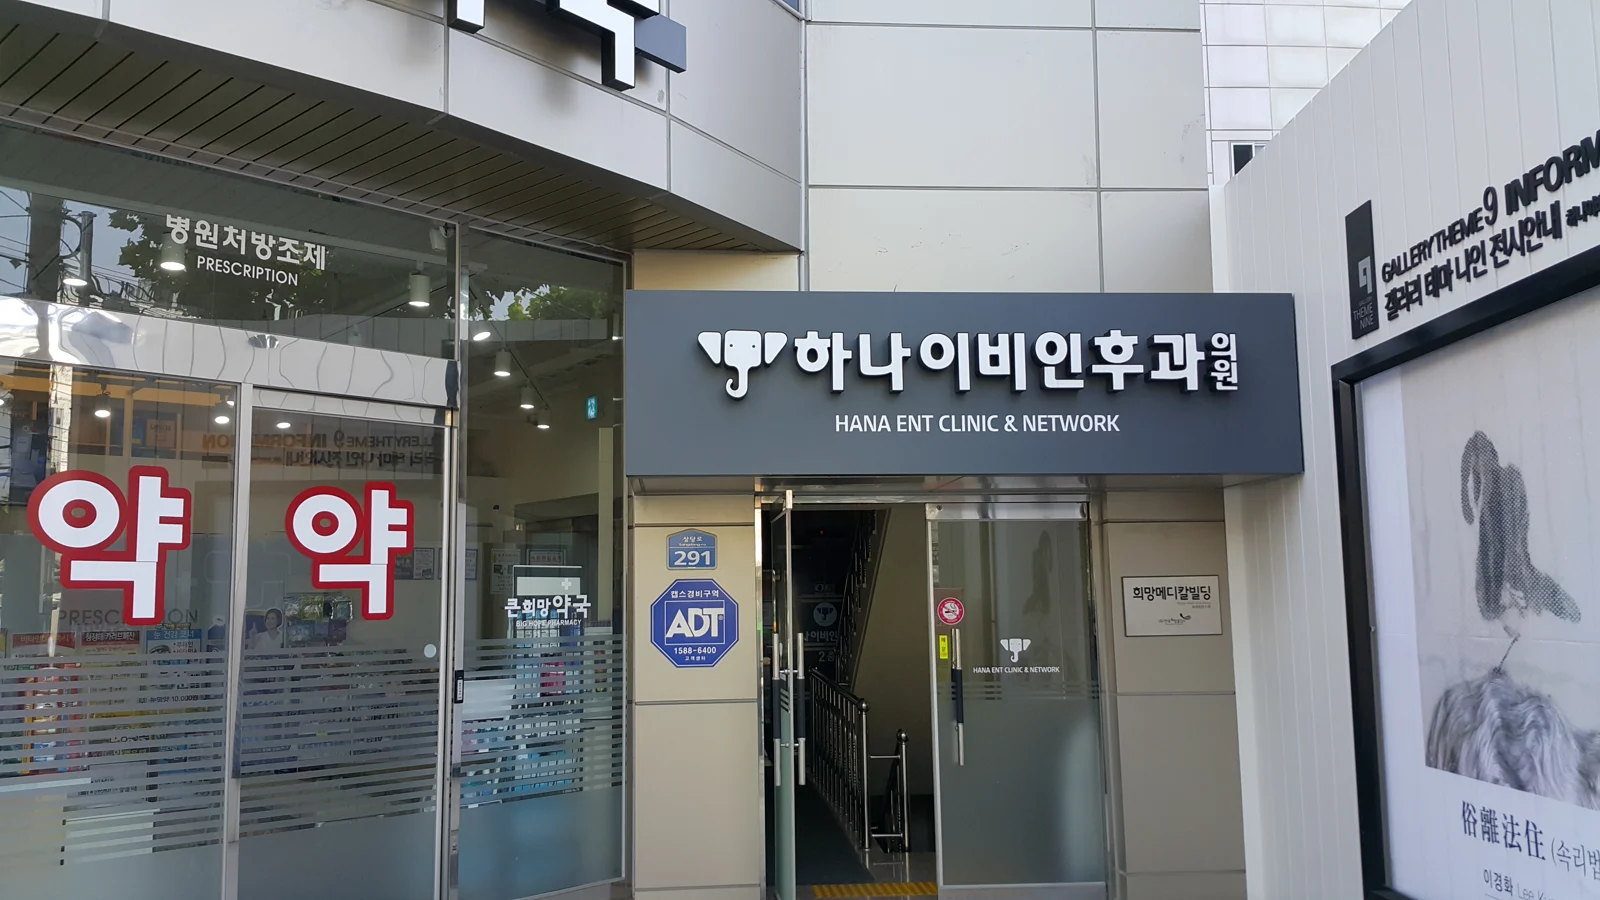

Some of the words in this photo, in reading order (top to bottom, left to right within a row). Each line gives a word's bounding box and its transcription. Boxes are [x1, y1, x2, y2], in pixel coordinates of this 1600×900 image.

[166, 214, 326, 270] 병원처방조제
[197, 255, 299, 287] PRESCRIPTION
[1384, 274, 1423, 321] 갤러리
[1424, 259, 1454, 298] 테마
[1455, 240, 1488, 282] 나인
[1489, 200, 1562, 268] 전시안내
[1353, 302, 1374, 320] THEME
[1359, 313, 1374, 329] NINE
[795, 329, 1206, 391] 하나이비인후과
[1210, 332, 1239, 391] 의원
[835, 414, 891, 432] HANA
[896, 414, 933, 432] ENT
[938, 414, 999, 432] CLINIC
[1004, 414, 1018, 432] &
[1023, 414, 1120, 432] NETWORK
[31, 468, 189, 624] 약
[287, 484, 411, 618] 약
[674, 550, 711, 566] 291
[670, 589, 719, 599] 캡스경비구역
[1133, 585, 1211, 601] 희망메디칼빌딩
[528, 619, 547, 627] HOPE
[665, 607, 724, 638] ADT
[674, 646, 717, 655] 1588-6400
[973, 666, 991, 674] HANA
[1461, 800, 1546, 860] 俗離法住
[1484, 869, 1513, 897] 이경화
